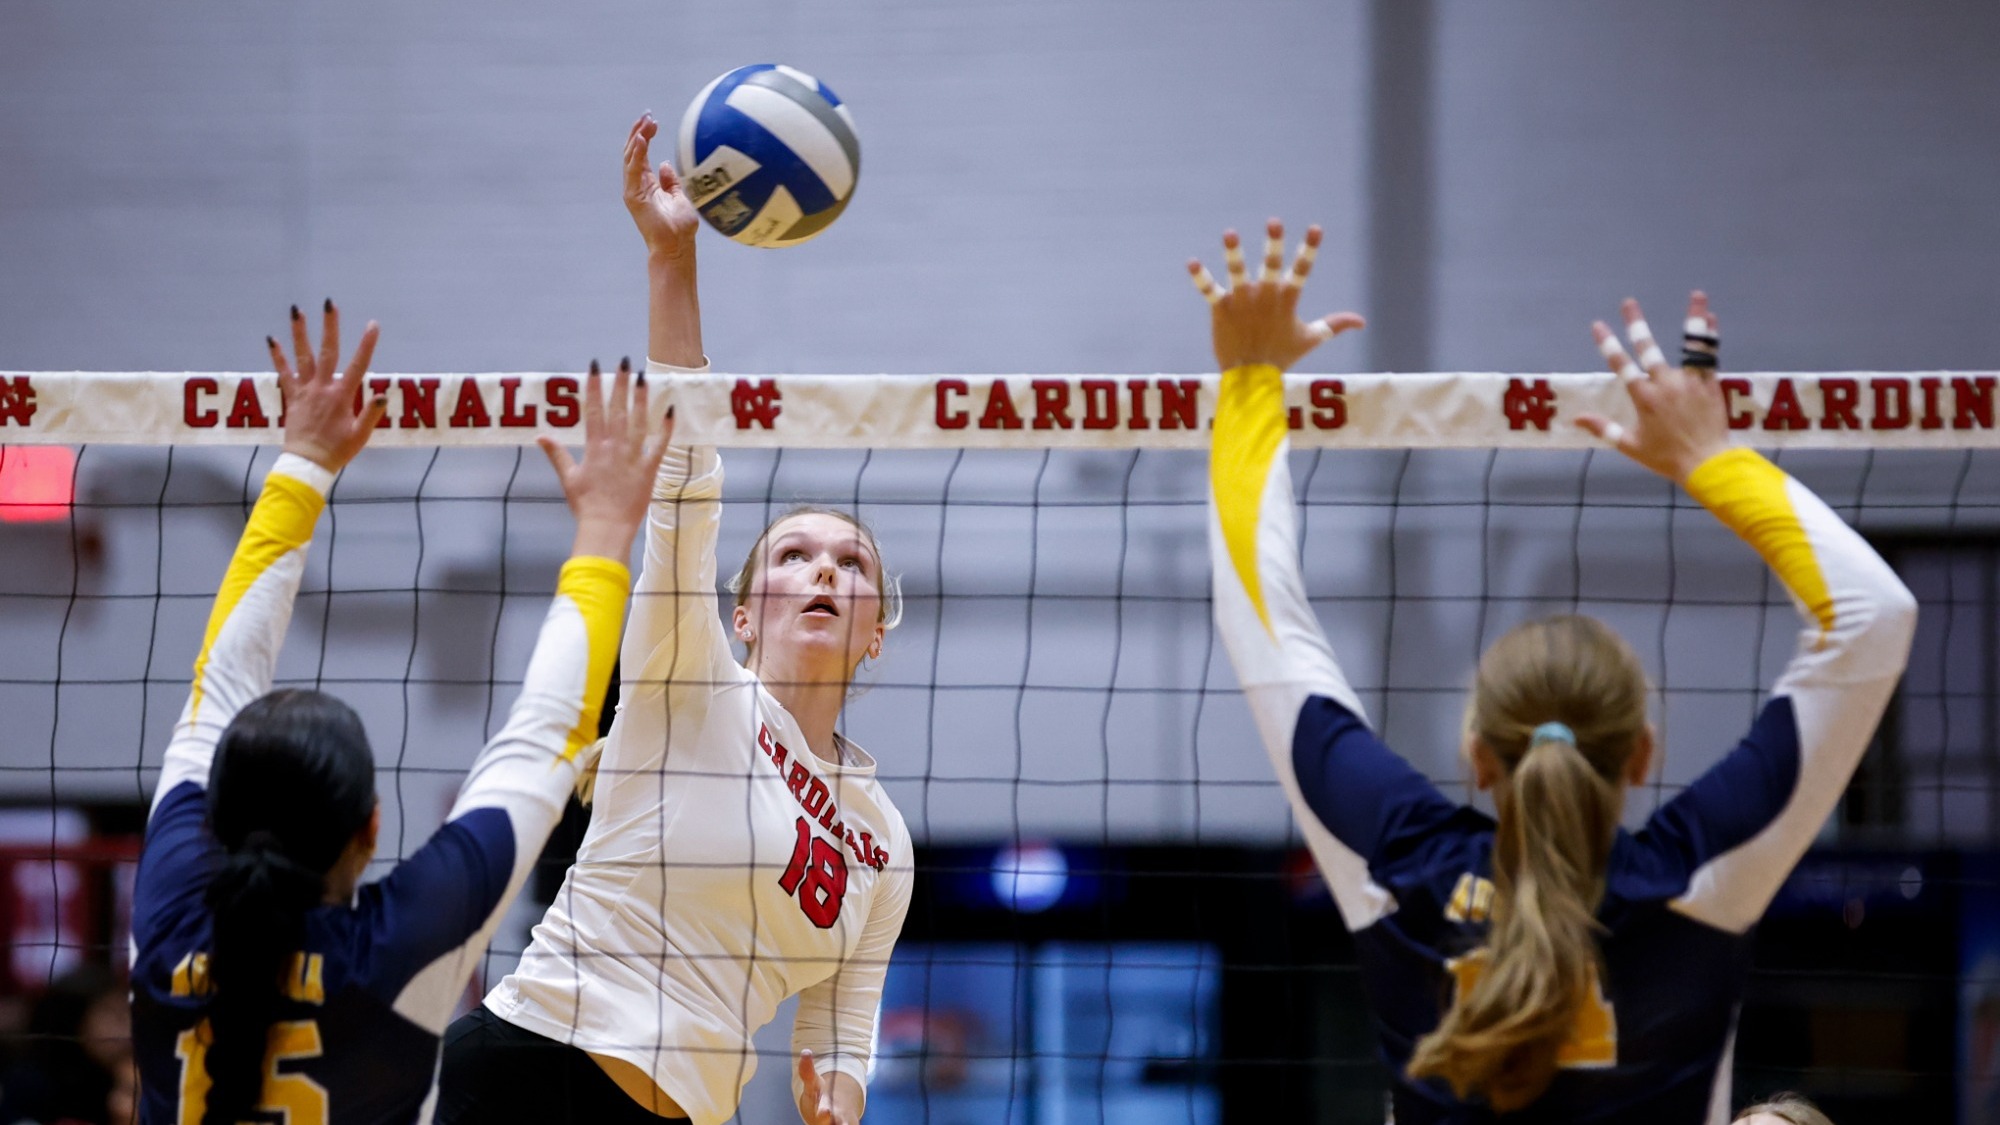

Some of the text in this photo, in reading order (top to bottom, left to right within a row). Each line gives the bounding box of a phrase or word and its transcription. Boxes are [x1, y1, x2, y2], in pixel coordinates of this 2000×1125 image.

[183, 377, 581, 428] CAINALS
[935, 379, 1348, 430] CARDINS
[778, 815, 849, 929] 18
